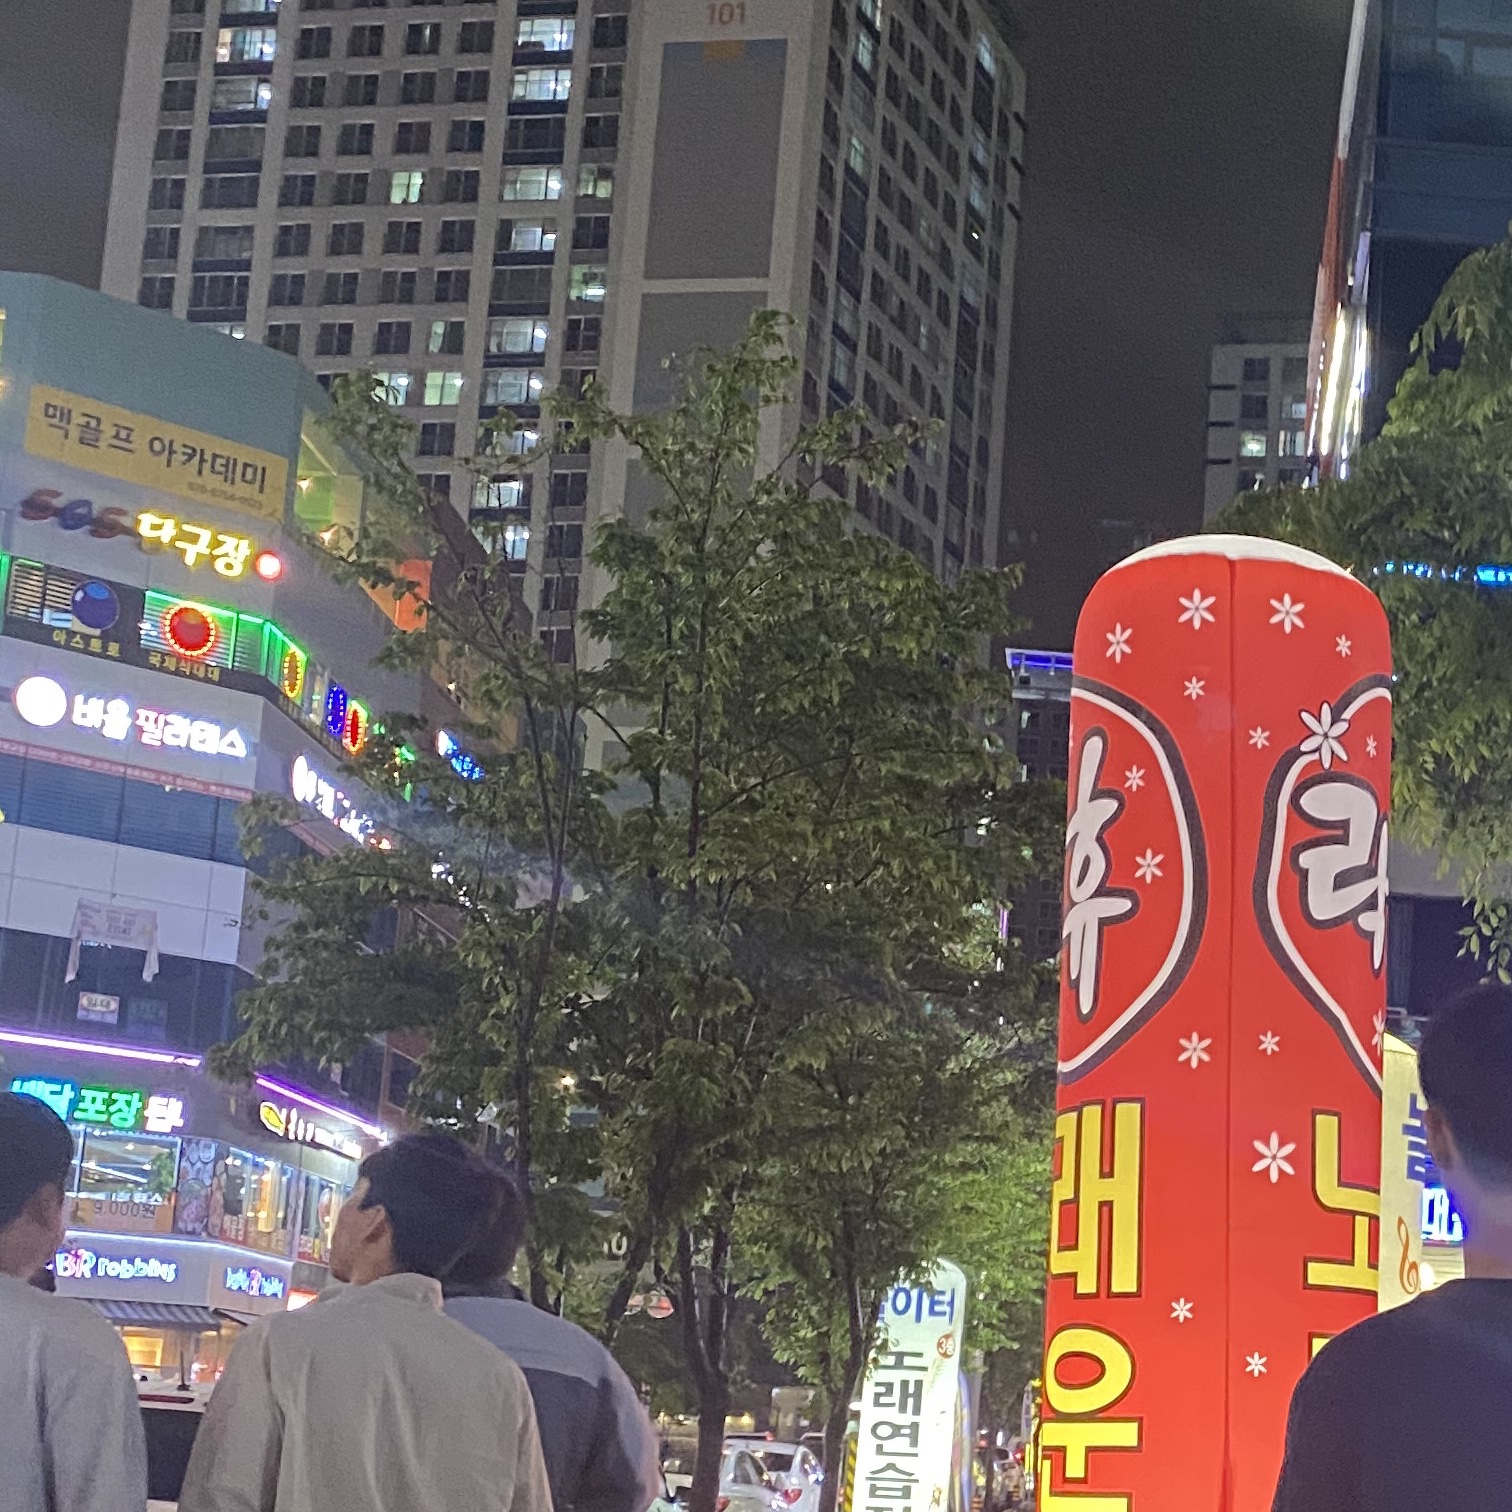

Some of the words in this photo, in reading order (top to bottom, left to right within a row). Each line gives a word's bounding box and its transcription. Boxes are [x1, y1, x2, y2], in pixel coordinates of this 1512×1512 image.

[706, 2, 748, 25] 101
[43, 401, 136, 454] 맥골프
[147, 435, 268, 494] 아카데미
[73, 1089, 143, 1128] 포장
